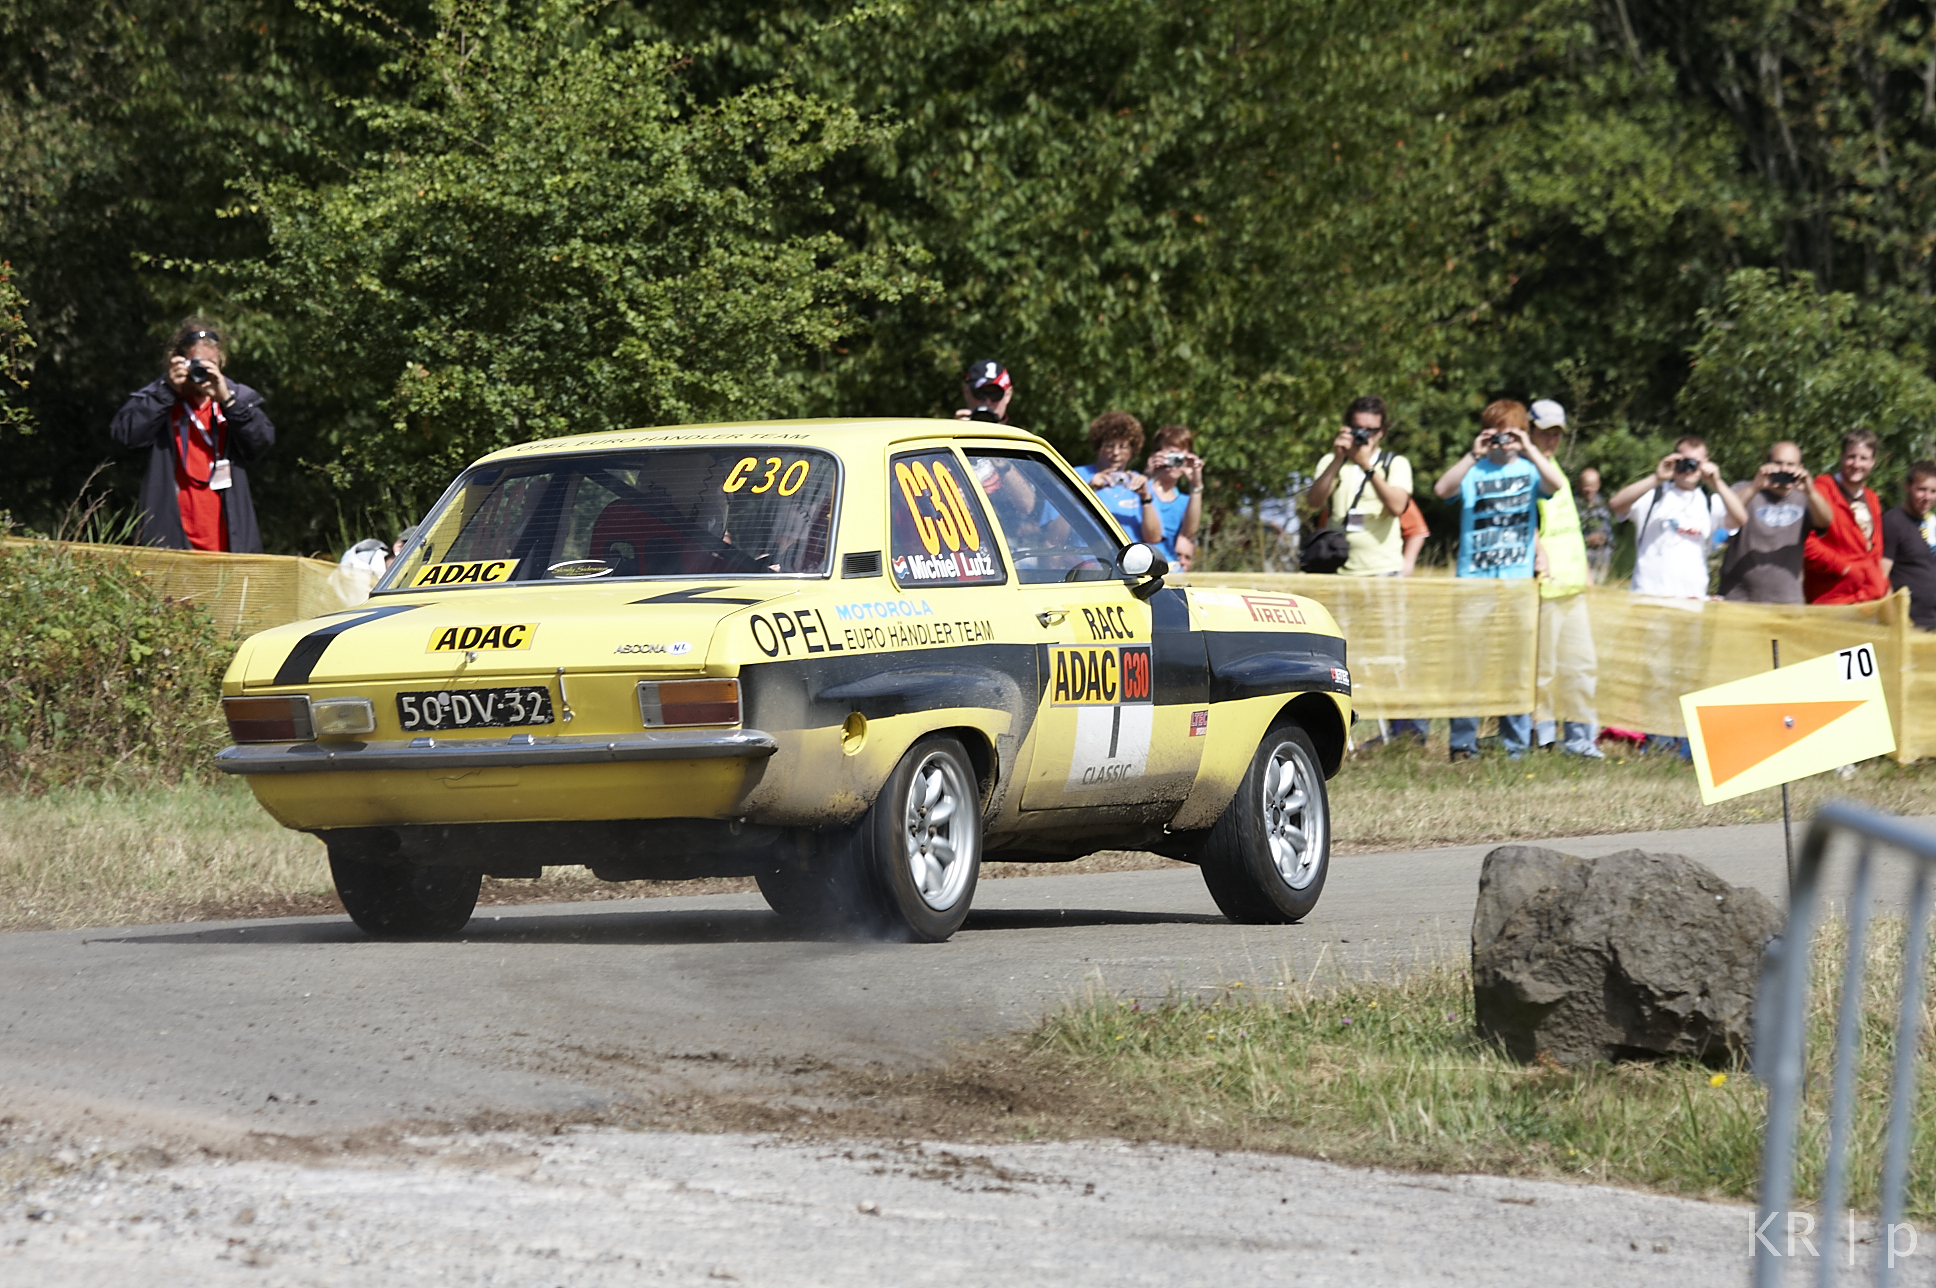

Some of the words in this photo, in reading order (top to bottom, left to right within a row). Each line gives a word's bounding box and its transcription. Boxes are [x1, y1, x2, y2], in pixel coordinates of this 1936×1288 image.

[985, 362, 997, 378] 1
[516, 442, 567, 452] OPEL
[575, 437, 636, 447] EURO
[894, 460, 980, 556] C30
[417, 562, 505, 586] ADAC
[907, 552, 961, 579] Michiel
[960, 552, 995, 576] Lutz
[835, 600, 934, 621] MOTOROLA
[1082, 606, 1133, 640] RACC
[1241, 595, 1306, 625] PIRELLI
[435, 624, 526, 651] ADAC
[673, 643, 687, 652] NL
[750, 609, 844, 658] OPEL
[845, 627, 886, 650] EURO
[889, 620, 955, 648] HÄNDLER
[955, 620, 995, 642] TEAM
[614, 644, 667, 654] ASCONA
[1054, 650, 1117, 702] ADAC
[1123, 651, 1149, 699] C30
[1839, 648, 1873, 680] 70
[402, 692, 545, 727] 50-DV-32
[1081, 763, 1132, 786] CLASSIC
